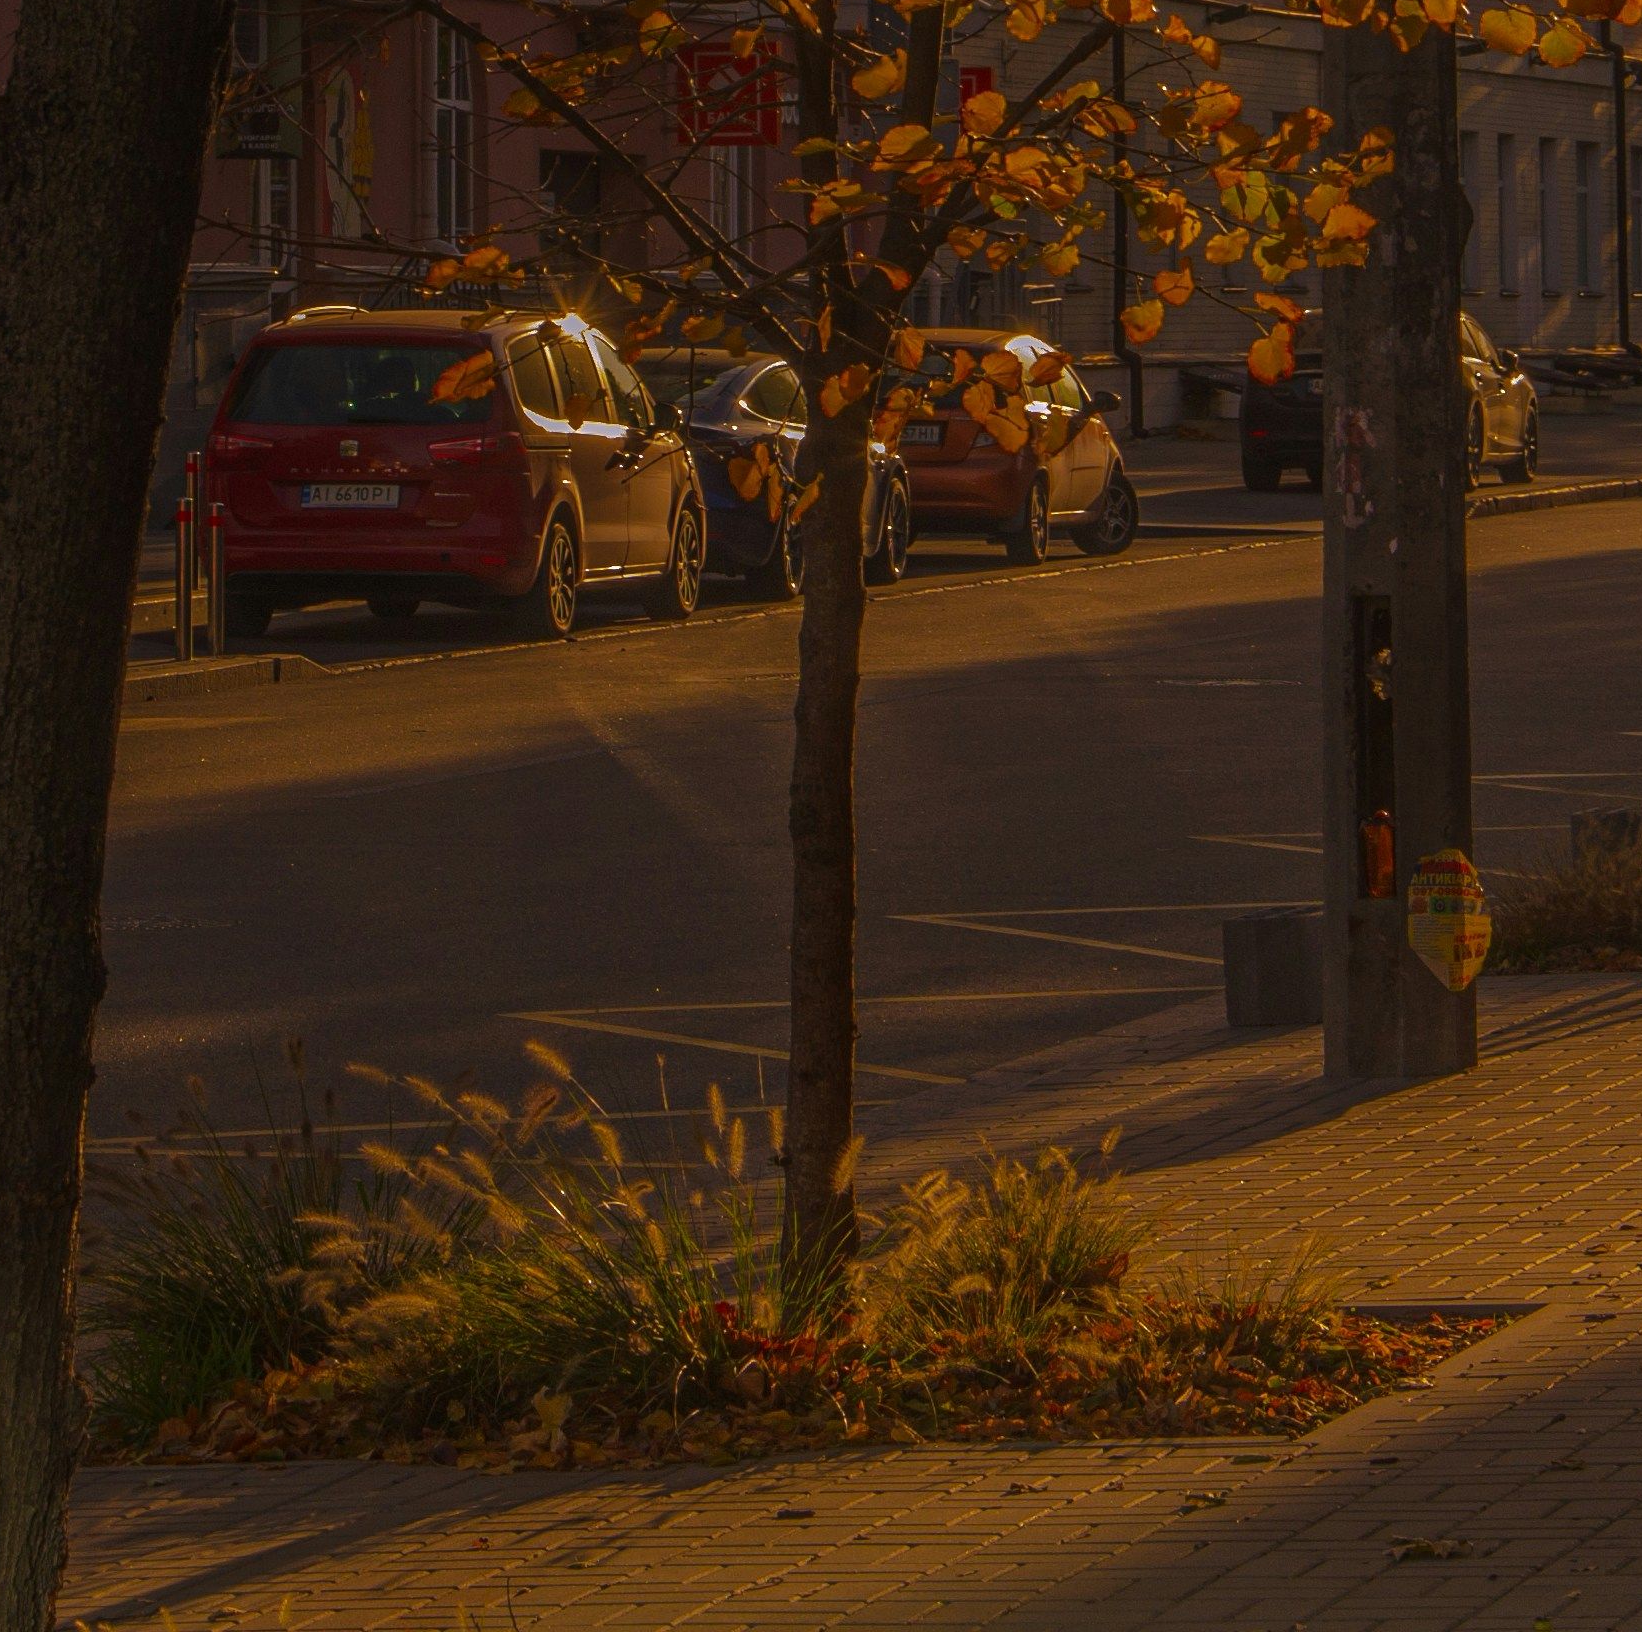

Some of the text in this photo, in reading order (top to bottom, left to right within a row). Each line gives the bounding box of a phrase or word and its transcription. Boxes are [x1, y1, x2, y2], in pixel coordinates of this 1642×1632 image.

[311, 487, 390, 501] AI 6610 PI
